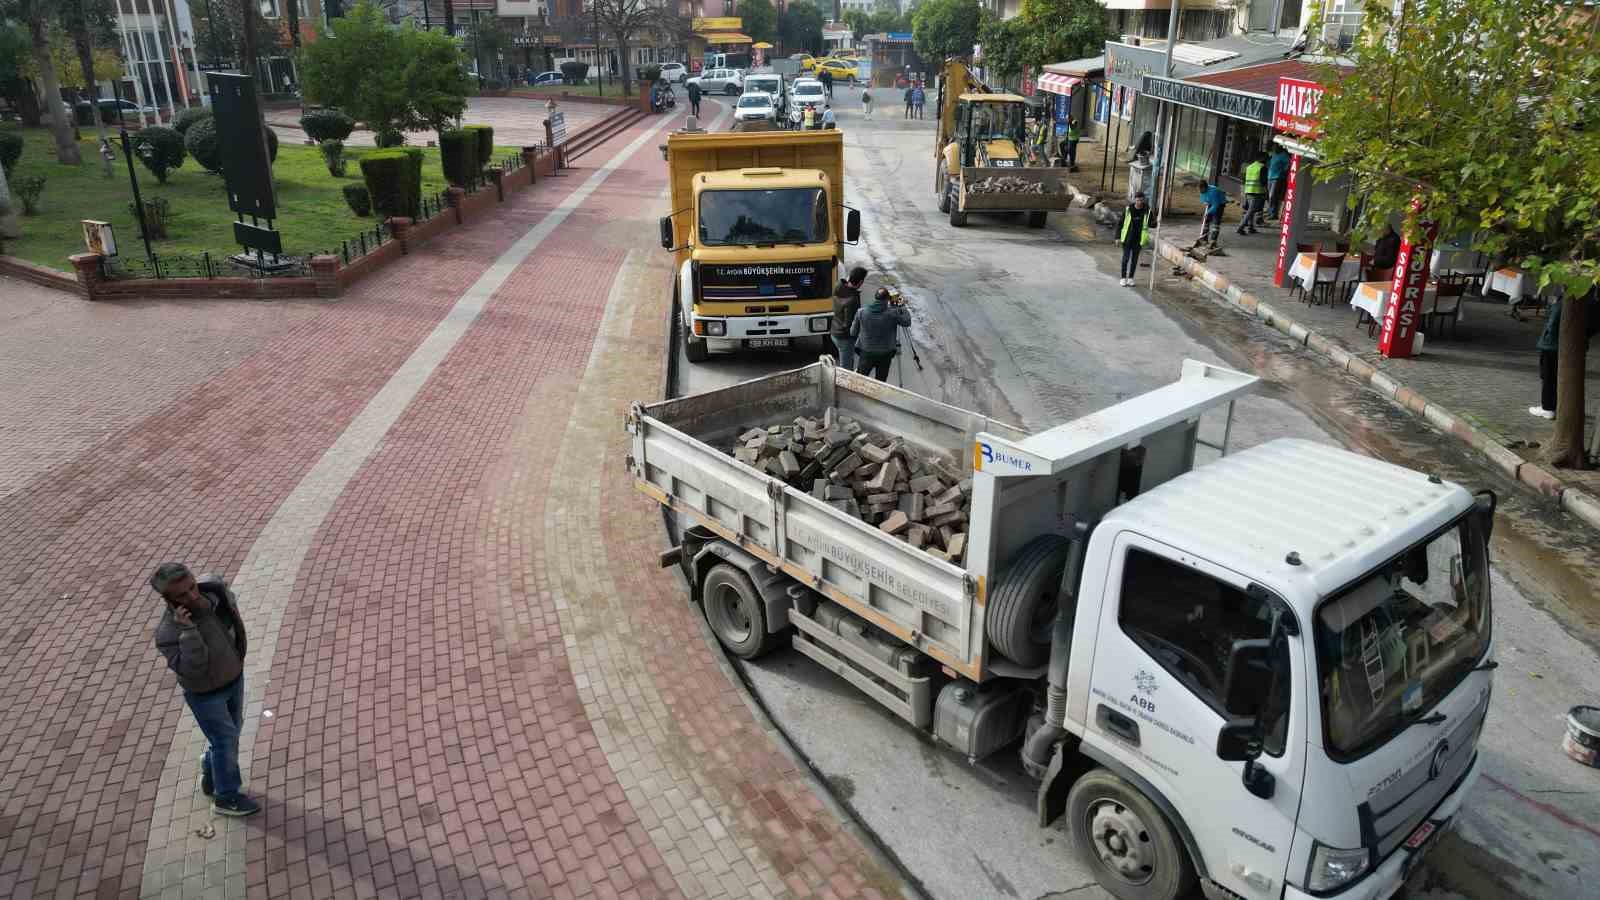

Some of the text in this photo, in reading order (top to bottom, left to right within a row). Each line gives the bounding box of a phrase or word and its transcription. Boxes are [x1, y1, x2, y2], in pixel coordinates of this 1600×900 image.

[1149, 79, 1179, 101] AVUKAT
[1277, 189, 1293, 268] SOFRASI
[1383, 252, 1406, 343] SOFRASI
[1400, 246, 1425, 338] SOFRASI
[996, 453, 1032, 472] BUMER
[1130, 694, 1155, 712] ABB
